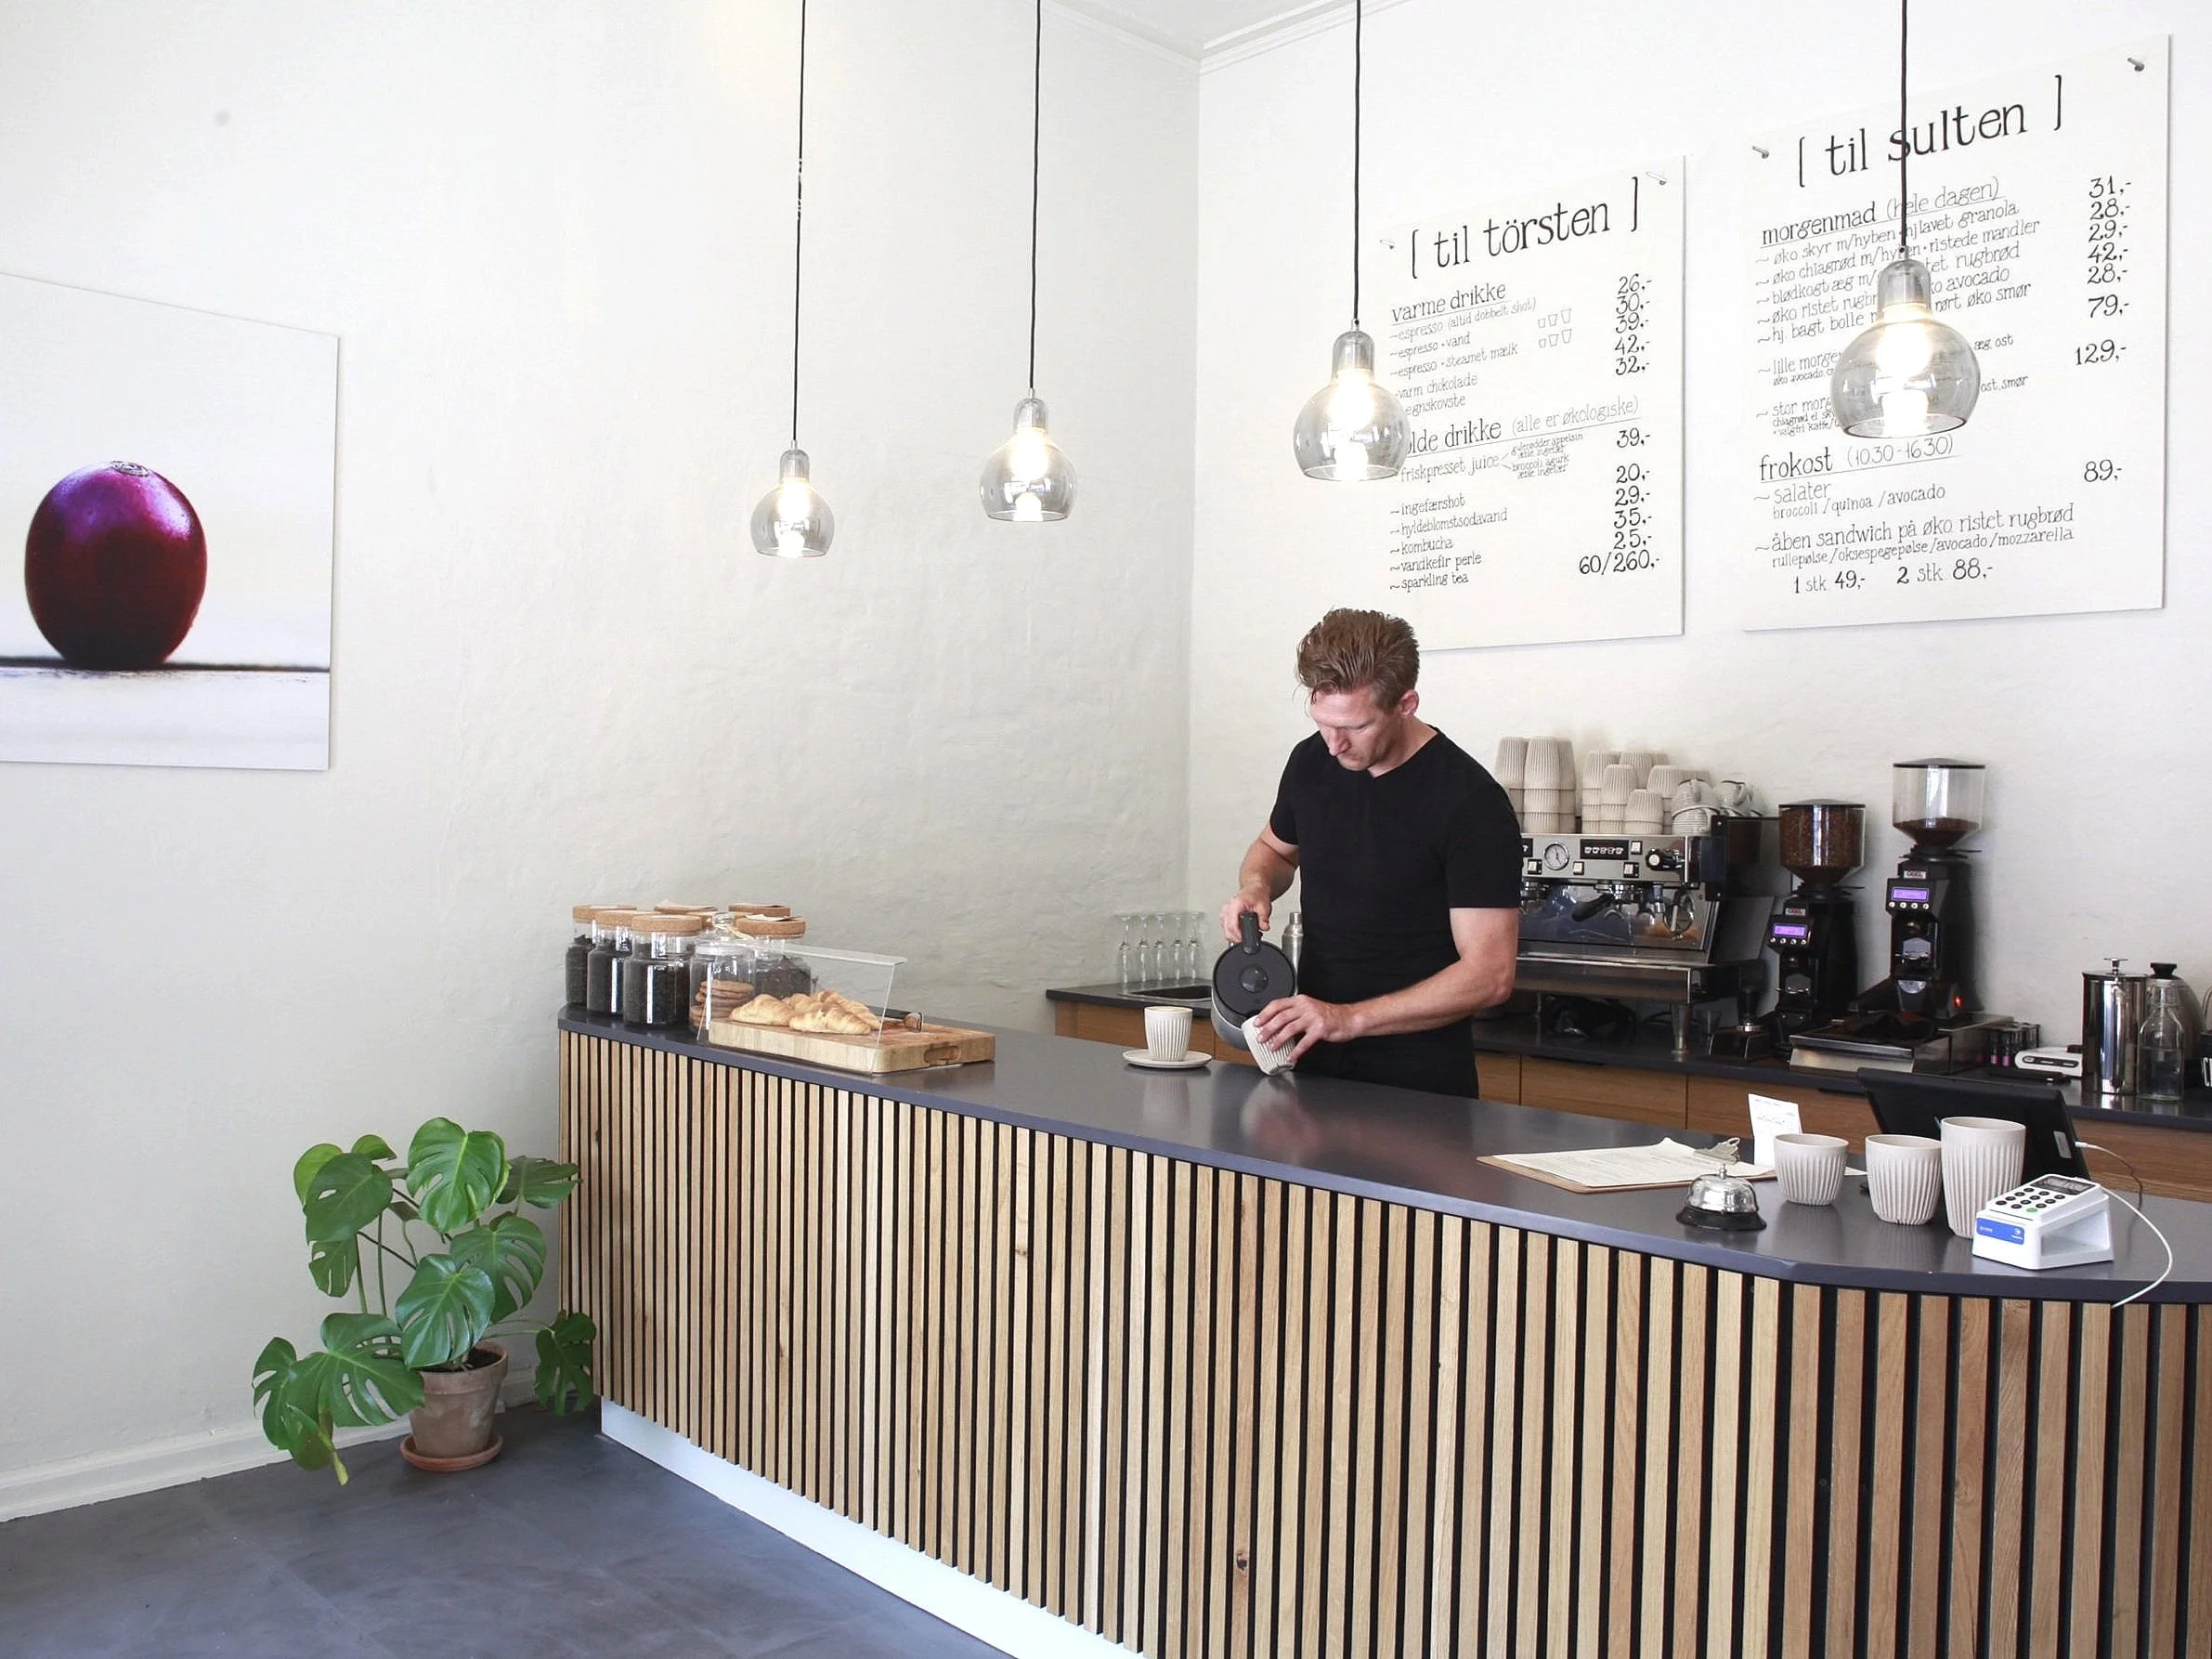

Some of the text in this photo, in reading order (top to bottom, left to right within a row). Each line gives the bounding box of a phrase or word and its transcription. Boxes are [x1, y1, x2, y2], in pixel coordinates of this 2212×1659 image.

[1825, 127, 1868, 176] til
[1888, 103, 2028, 162] sulten
[1763, 201, 1877, 244] morgenmad
[1934, 176, 1999, 208] dagen)
[1774, 248, 1798, 265] øko
[1802, 241, 1832, 258] skyr
[1958, 199, 2021, 229] granola
[1434, 225, 1470, 268] til
[1483, 202, 1610, 256] törsten
[1773, 268, 1795, 285] øko
[1799, 252, 1855, 275] chiagrød
[1929, 230, 1979, 253] ristede
[1983, 218, 2041, 243] mandler
[1772, 278, 1830, 304] blødkogt
[1831, 275, 1855, 292] æg
[1957, 240, 2020, 268] rugbrød
[1392, 282, 1506, 322] varme drikke
[1772, 307, 1797, 324] øko
[1802, 294, 1840, 318] ristet
[1946, 266, 2010, 293] avocado
[1791, 318, 1825, 339] bagt
[1829, 312, 1865, 332] bolle
[1967, 289, 1992, 307] øko
[1996, 282, 2032, 302] smør
[1426, 372, 1477, 395] chokolade
[1773, 356, 1797, 375] lille
[1404, 393, 1466, 417] egnskovste
[1406, 395, 1639, 454] lde drikke (alle er økologiske)
[1468, 454, 1500, 477] juice
[1760, 446, 1833, 480] frokost
[1774, 481, 1832, 504] salater
[1400, 536, 1454, 555] kombucha
[1771, 502, 2074, 552] åben sandwich på øko ristet rugbrød
[1400, 571, 1469, 593] sparkling tea
[1793, 575, 1800, 594] 1
[1805, 574, 1828, 592] stk
[1896, 566, 1910, 584] 2
[1917, 562, 1944, 581] stk
